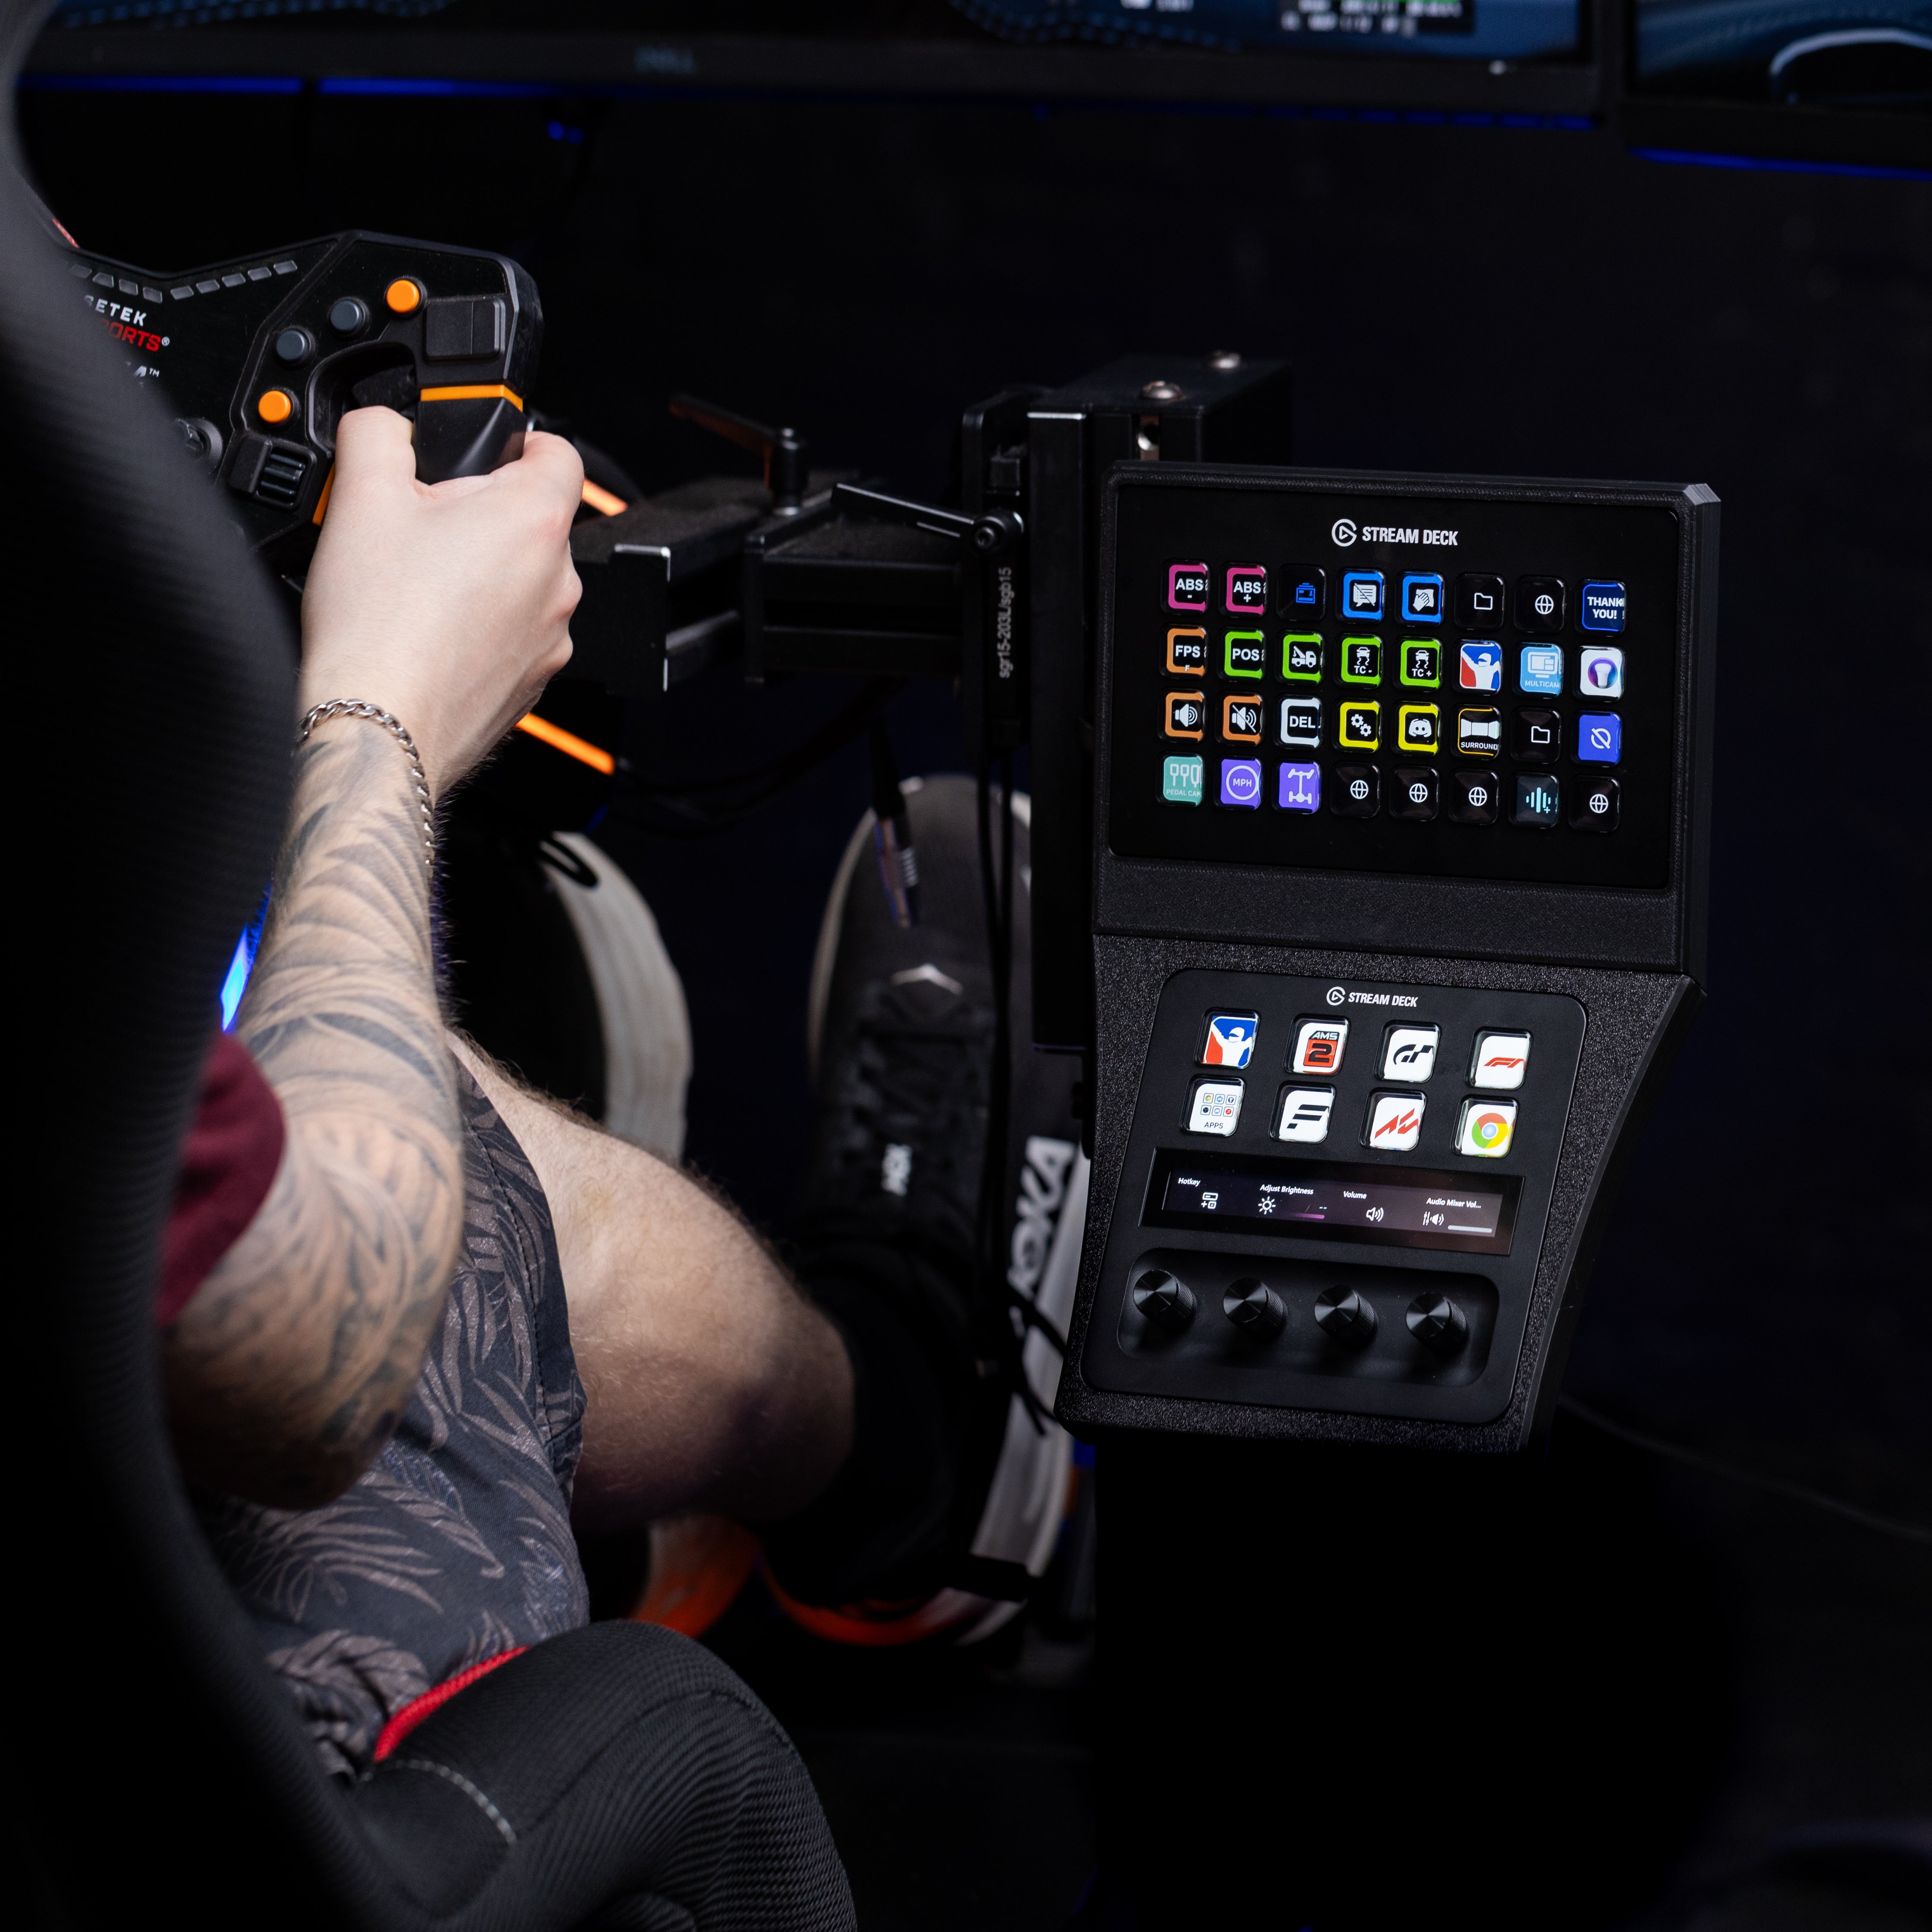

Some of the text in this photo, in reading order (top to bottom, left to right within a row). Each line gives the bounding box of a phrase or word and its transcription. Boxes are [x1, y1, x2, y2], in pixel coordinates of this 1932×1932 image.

[1362, 527, 1458, 546] STREAM DECK
[1176, 578, 1203, 591] ABS
[1233, 581, 1261, 594] ABS
[1592, 608, 1617, 619] YOU!
[1175, 645, 1200, 658] FPS
[1233, 648, 1259, 661] POS
[1354, 665, 1366, 674] TC
[1411, 669, 1424, 677] TC
[1524, 680, 1560, 689] MULTICAM
[1289, 716, 1315, 728] DEL
[1461, 742, 1498, 750] SURROUND
[1233, 778, 1251, 787] MPH
[1348, 992, 1419, 1007] STREAM DECK
[1312, 1031, 1338, 1041] AMS
[1308, 1042, 1333, 1063] 2
[1178, 1177, 1201, 1186] Hotkey
[1260, 1184, 1314, 1195] Adjust Brightness
[1343, 1191, 1367, 1199] Volume
[1426, 1198, 1446, 1206] Audio
[1446, 1199, 1465, 1208] Mixer
